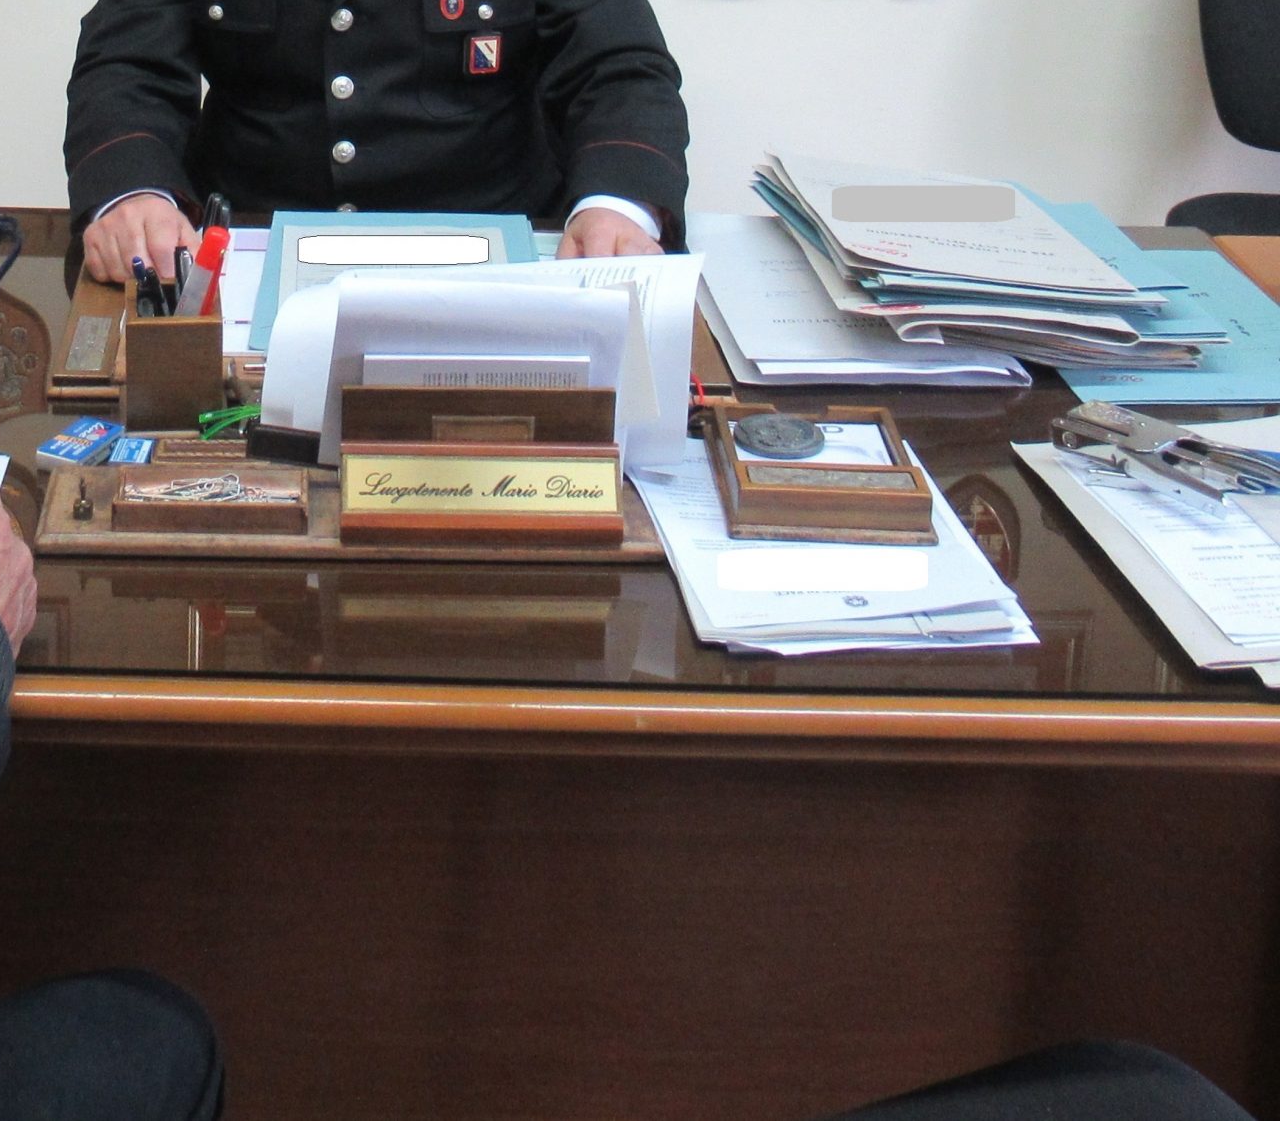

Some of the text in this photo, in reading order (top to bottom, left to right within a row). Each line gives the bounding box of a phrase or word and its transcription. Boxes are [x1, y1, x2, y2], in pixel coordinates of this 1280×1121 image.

[358, 472, 605, 504] Luogotenente Mario Diario
